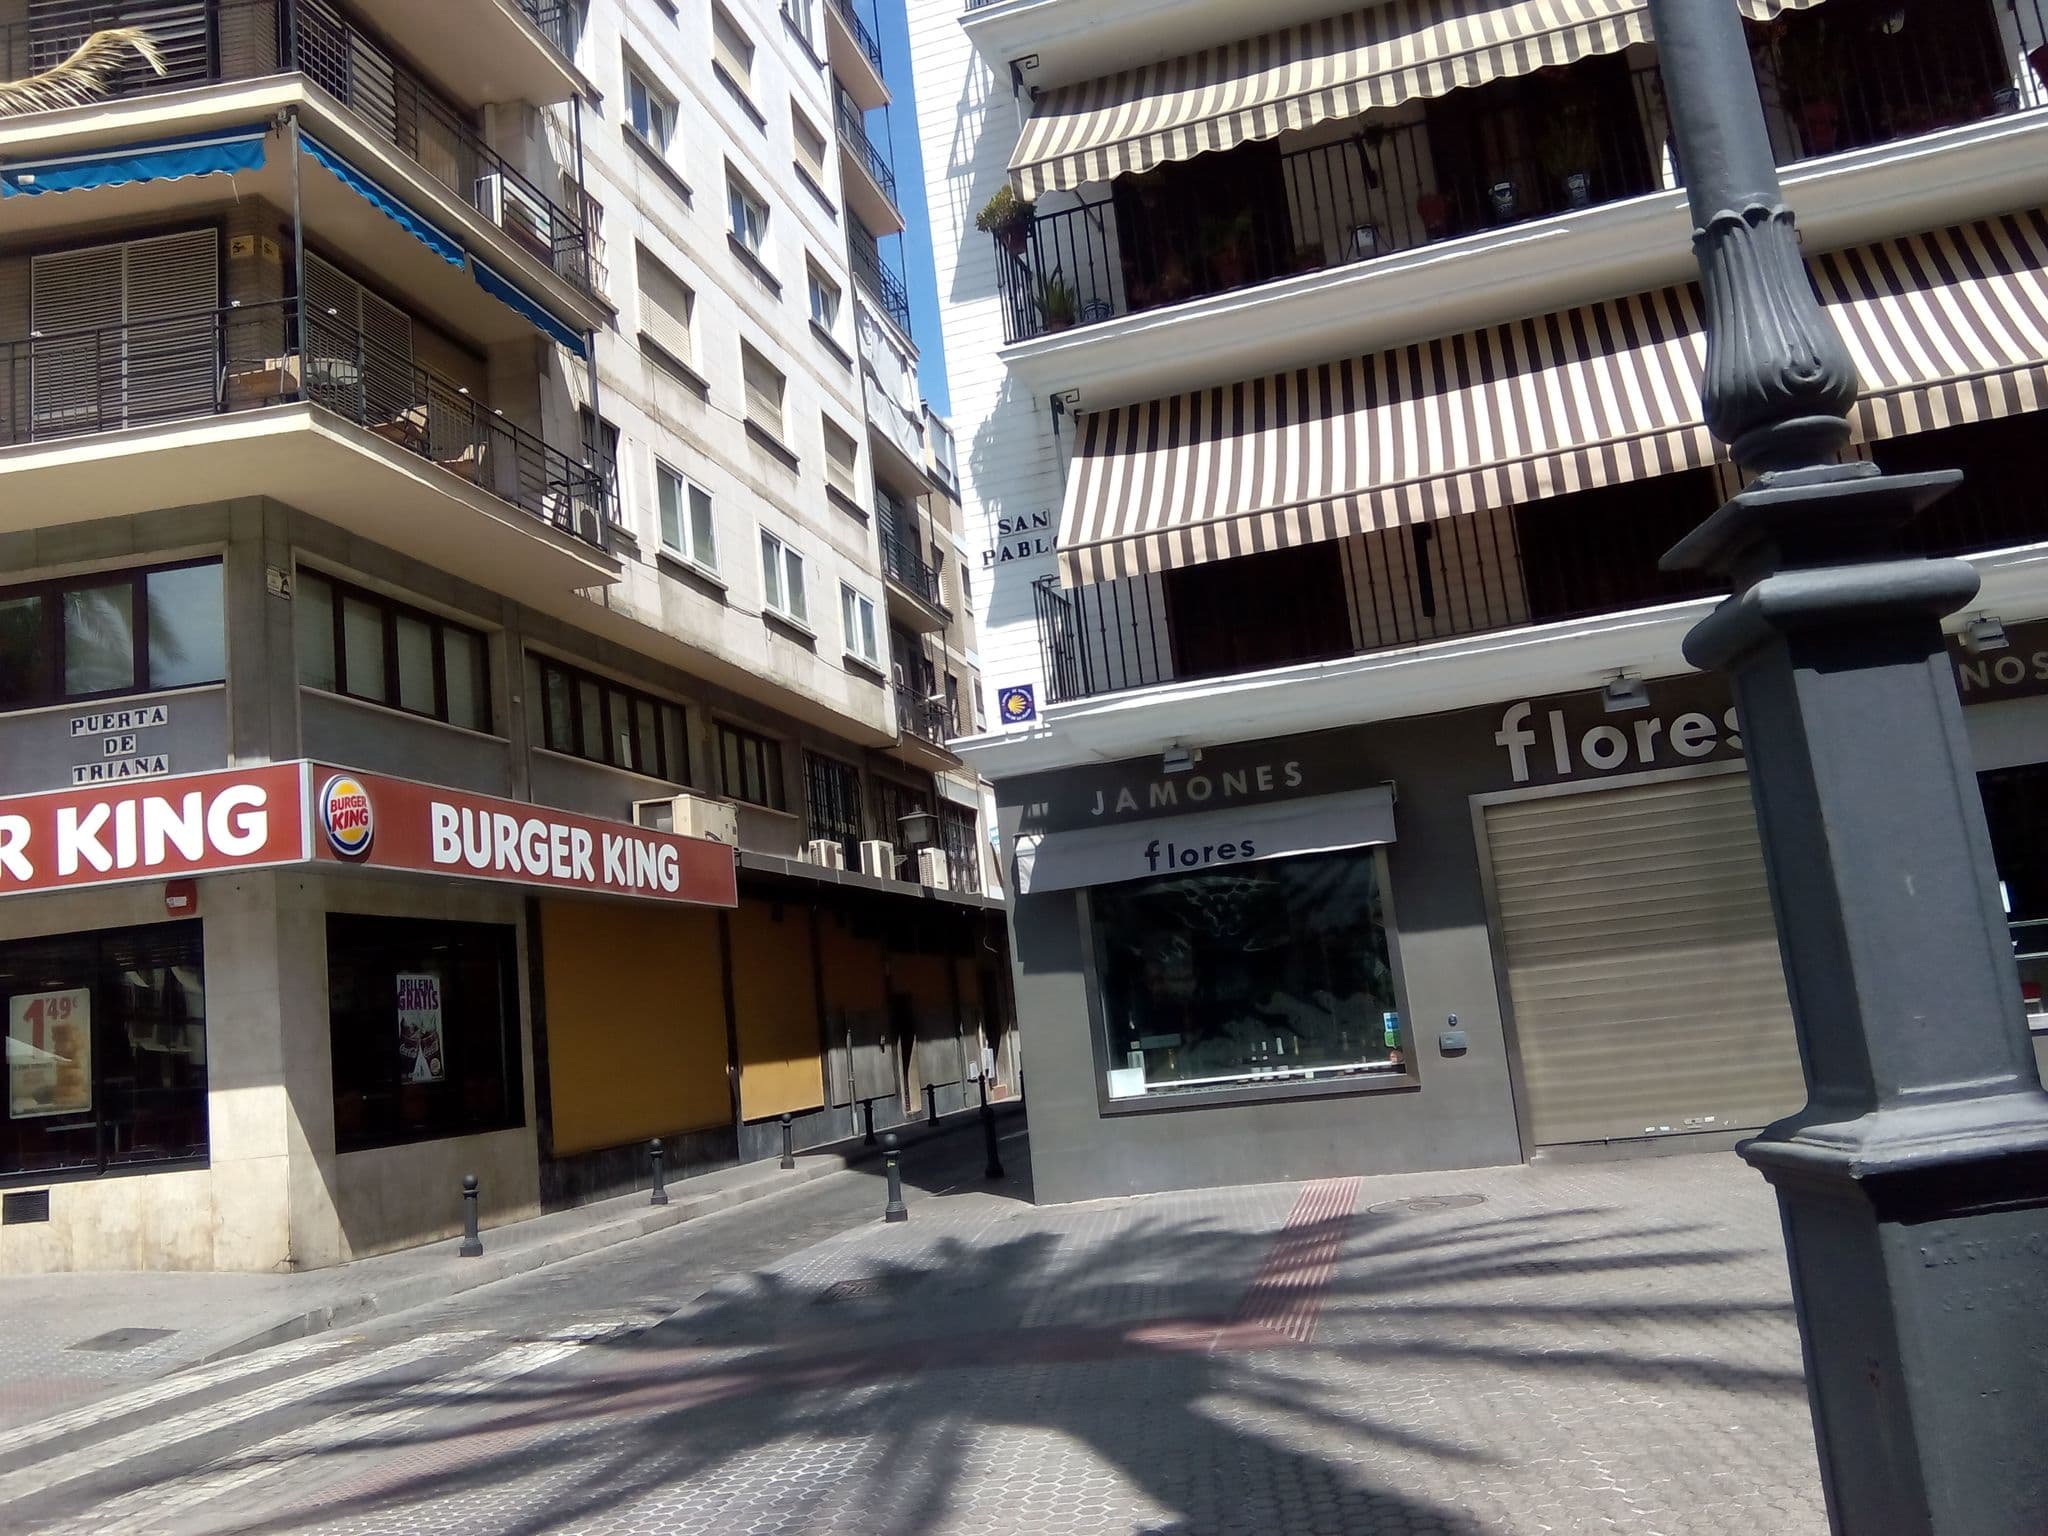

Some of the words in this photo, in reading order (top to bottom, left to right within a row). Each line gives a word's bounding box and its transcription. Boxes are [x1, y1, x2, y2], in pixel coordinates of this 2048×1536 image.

[998, 511, 1048, 535] SAN
[982, 535, 1059, 566] PABL
[70, 705, 167, 737] PUERTA
[104, 735, 135, 755] DE
[72, 757, 167, 784] TRIANA
[1090, 760, 1303, 816] JAMONES
[330, 795, 367, 813] BURGER
[57, 784, 269, 876] KING
[331, 808, 368, 832] KING
[430, 801, 595, 882] BURGER
[602, 832, 680, 892] KING
[1144, 839, 1257, 872] flores
[398, 990, 439, 1011] GRATIS
